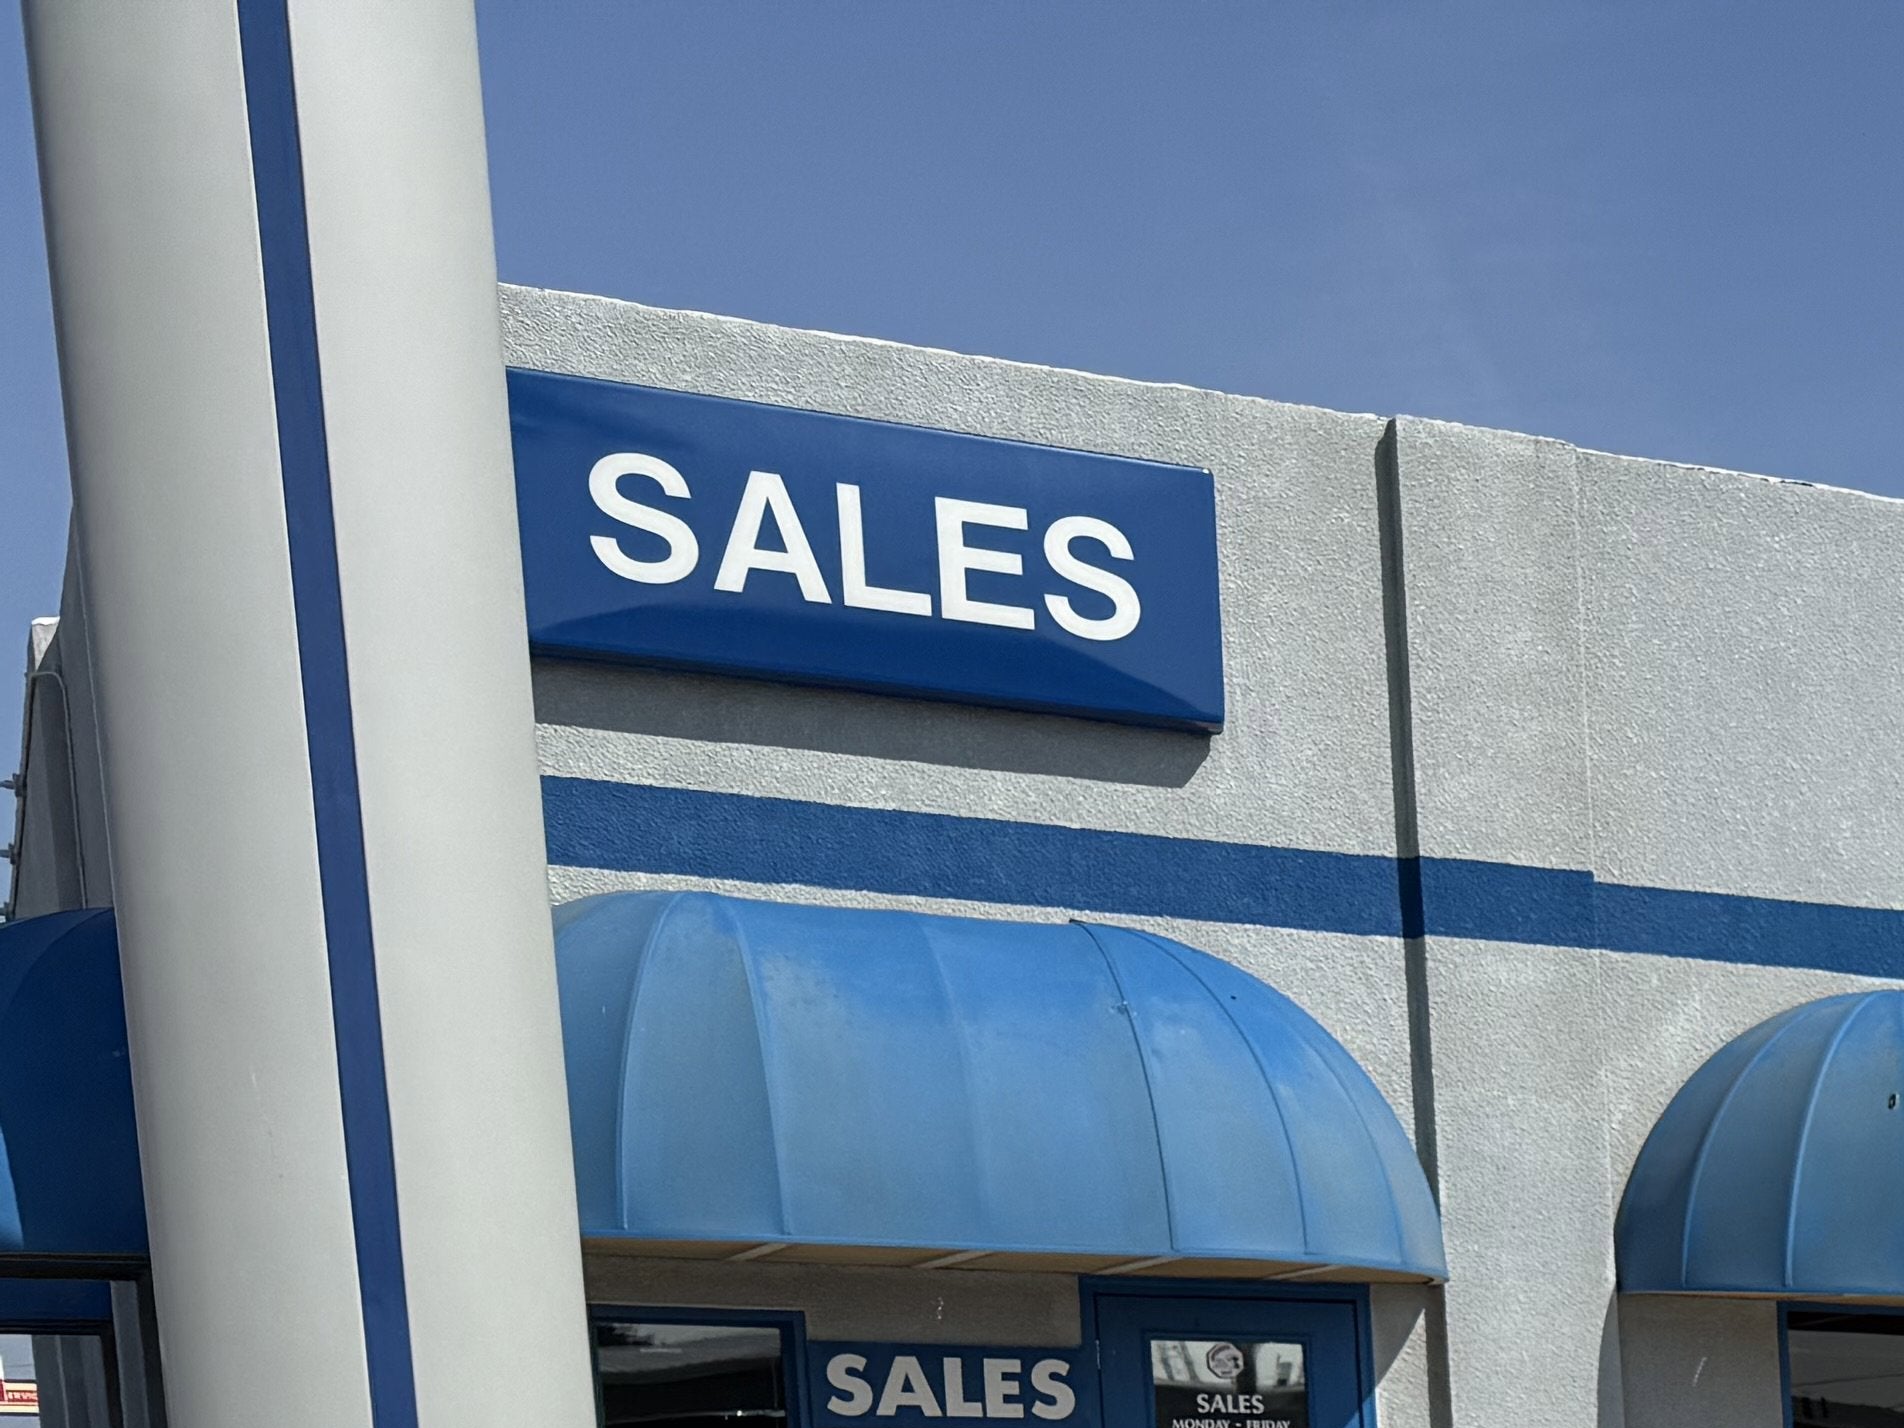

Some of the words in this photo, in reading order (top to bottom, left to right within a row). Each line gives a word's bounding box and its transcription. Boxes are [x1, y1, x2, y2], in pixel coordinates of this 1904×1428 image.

[588, 452, 1141, 641] SALES
[826, 1353, 1076, 1420] SALES
[1196, 1393, 1265, 1414] SALES
